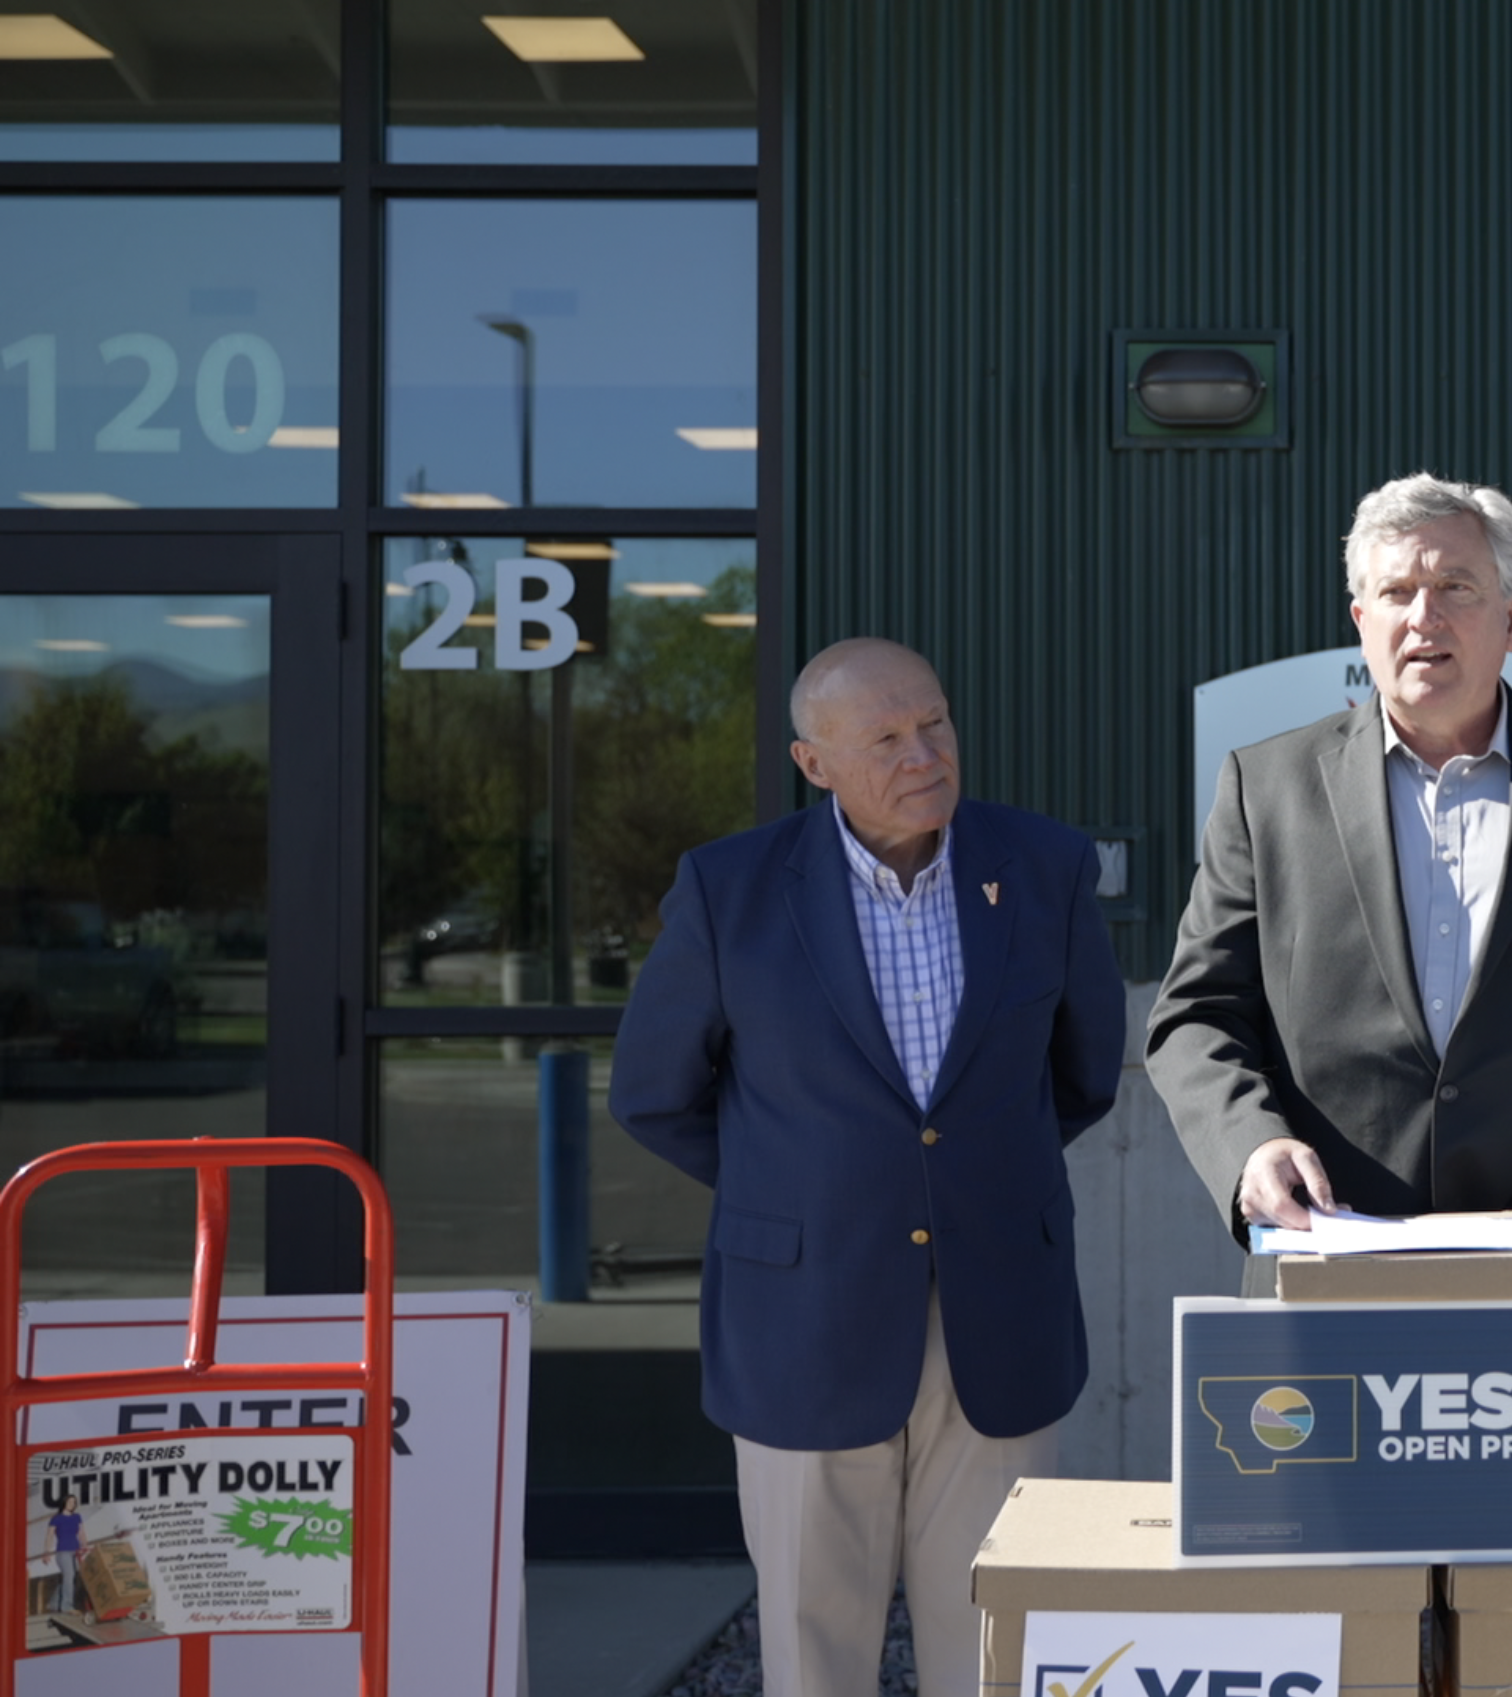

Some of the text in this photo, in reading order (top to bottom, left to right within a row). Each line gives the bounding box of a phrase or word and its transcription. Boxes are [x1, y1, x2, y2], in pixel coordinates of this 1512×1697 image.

[2, 333, 286, 453] 120
[400, 557, 579, 671] 2B
[43, 1445, 186, 1472] U-HAUL PRO-SERIES
[1378, 1435, 1470, 1461] OPEN
[43, 1460, 343, 1509] UTILITY DOLLY
